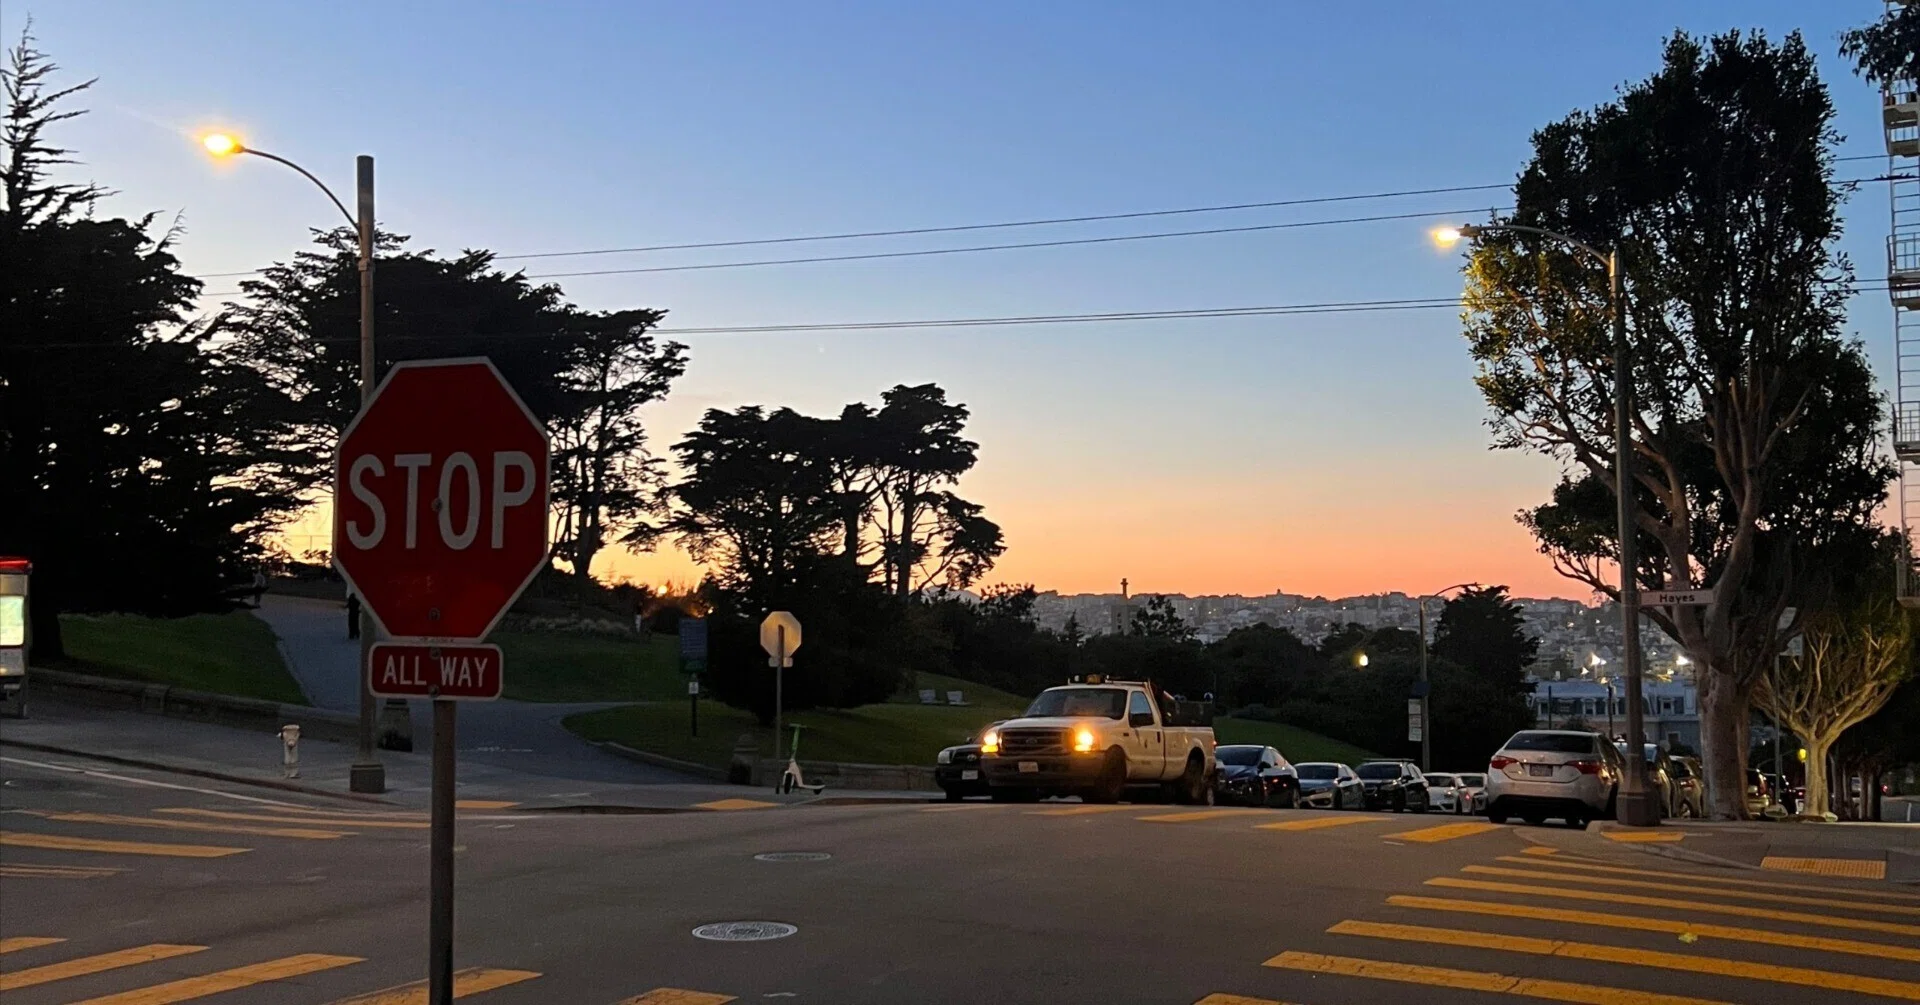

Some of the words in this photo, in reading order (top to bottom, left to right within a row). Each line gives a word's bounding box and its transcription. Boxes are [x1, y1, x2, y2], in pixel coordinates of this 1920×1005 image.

[346, 451, 537, 550] STOP
[1659, 594, 1695, 604] Hayes
[382, 655, 427, 687] ALL
[439, 656, 488, 688] WAY
